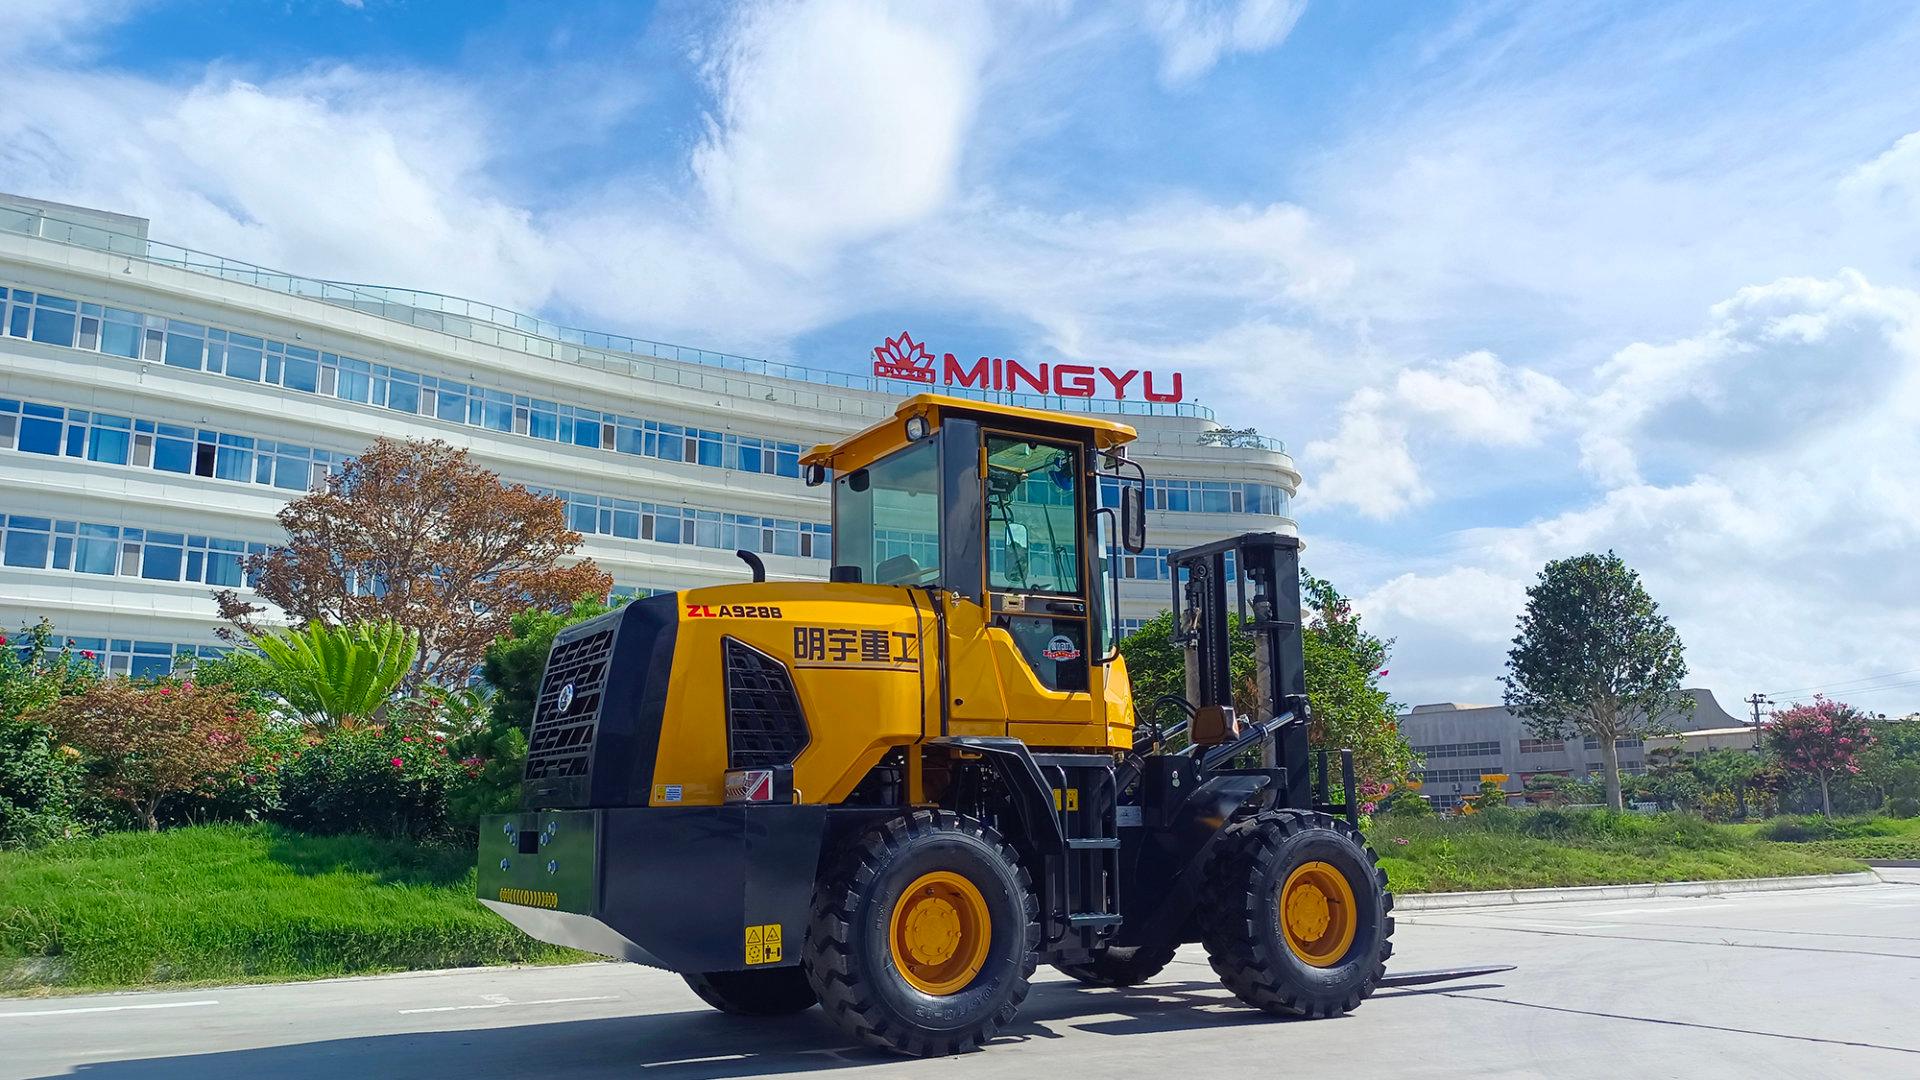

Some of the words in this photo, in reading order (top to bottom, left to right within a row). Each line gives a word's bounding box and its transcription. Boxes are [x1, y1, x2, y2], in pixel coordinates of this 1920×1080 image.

[944, 353, 1183, 403] MINGYU
[793, 626, 918, 664] 明宇重工
